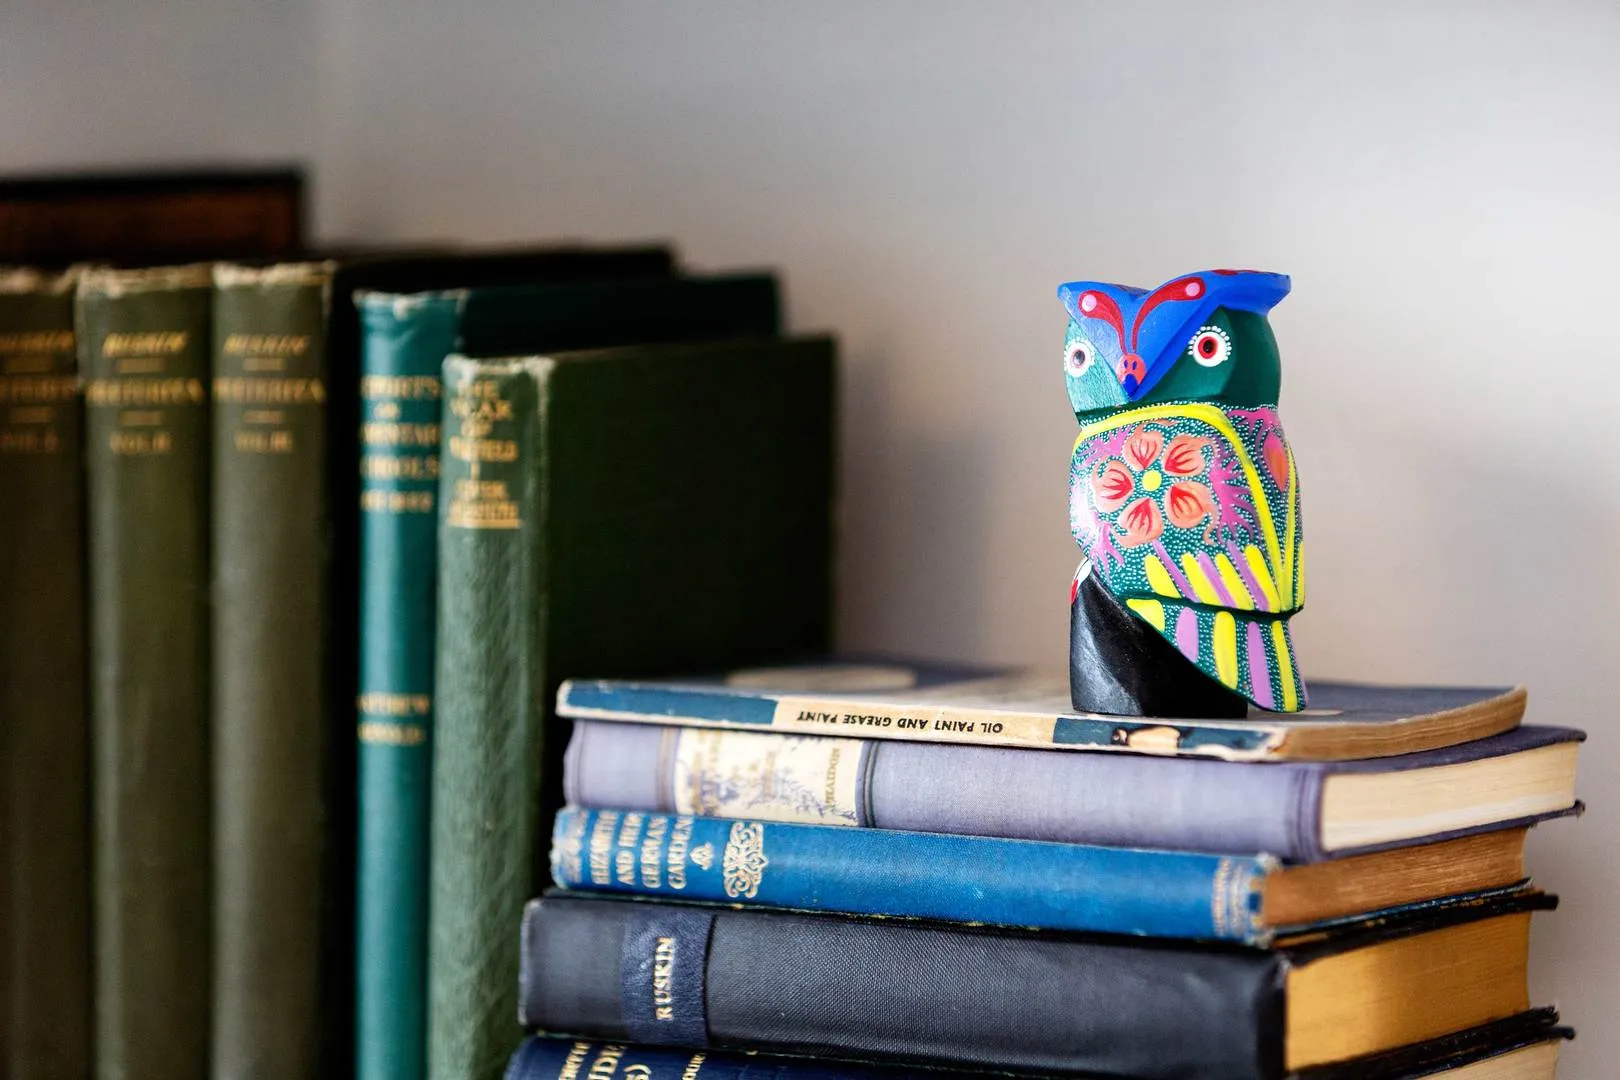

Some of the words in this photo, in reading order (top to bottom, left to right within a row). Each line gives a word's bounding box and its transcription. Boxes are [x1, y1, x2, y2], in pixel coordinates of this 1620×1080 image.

[796, 711, 838, 723] PAINT
[842, 714, 891, 727] GREASE
[897, 718, 928, 729] AND
[934, 720, 975, 732] PAINT
[981, 722, 1003, 733] OIL
[617, 811, 644, 847] HER
[640, 815, 669, 888] GERMAN
[667, 815, 695, 889] GARDEN
[615, 850, 637, 885] AND
[652, 935, 676, 1020] RUSKIN
